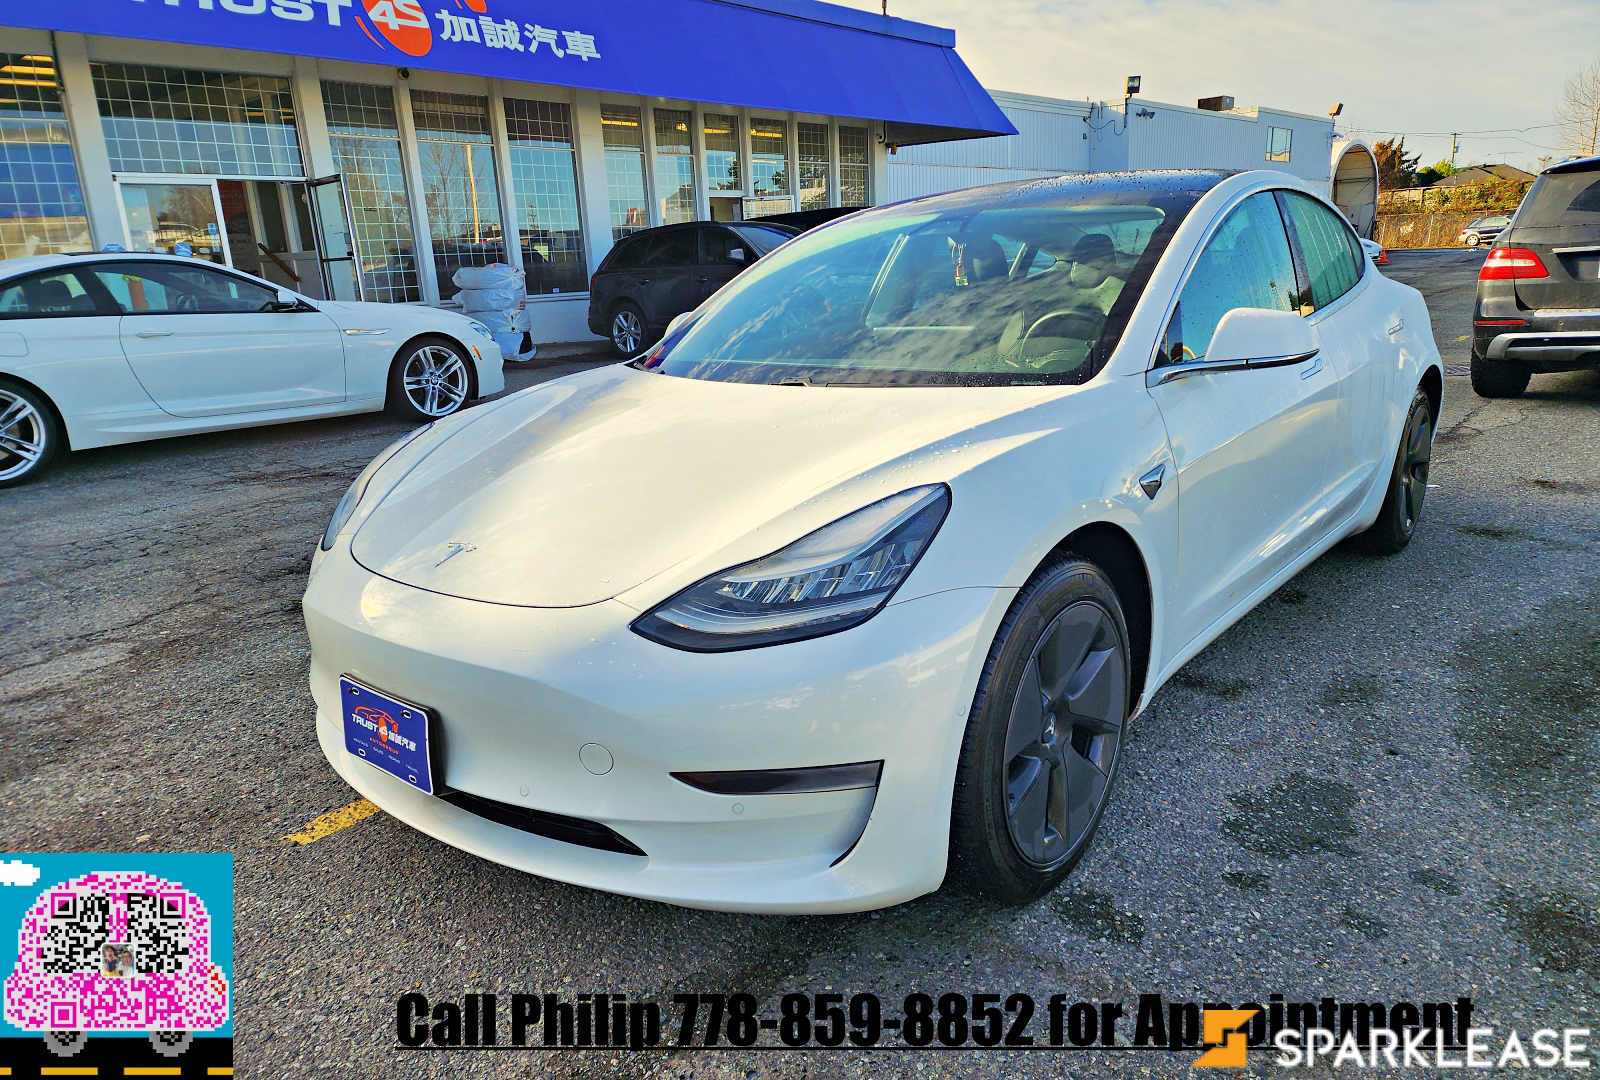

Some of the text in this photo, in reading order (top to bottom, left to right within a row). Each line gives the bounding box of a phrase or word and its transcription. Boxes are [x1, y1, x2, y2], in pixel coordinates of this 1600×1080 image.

[368, 0, 430, 30] 4S
[434, 8, 601, 62] 加誠汽車
[351, 713, 378, 732] TRUST
